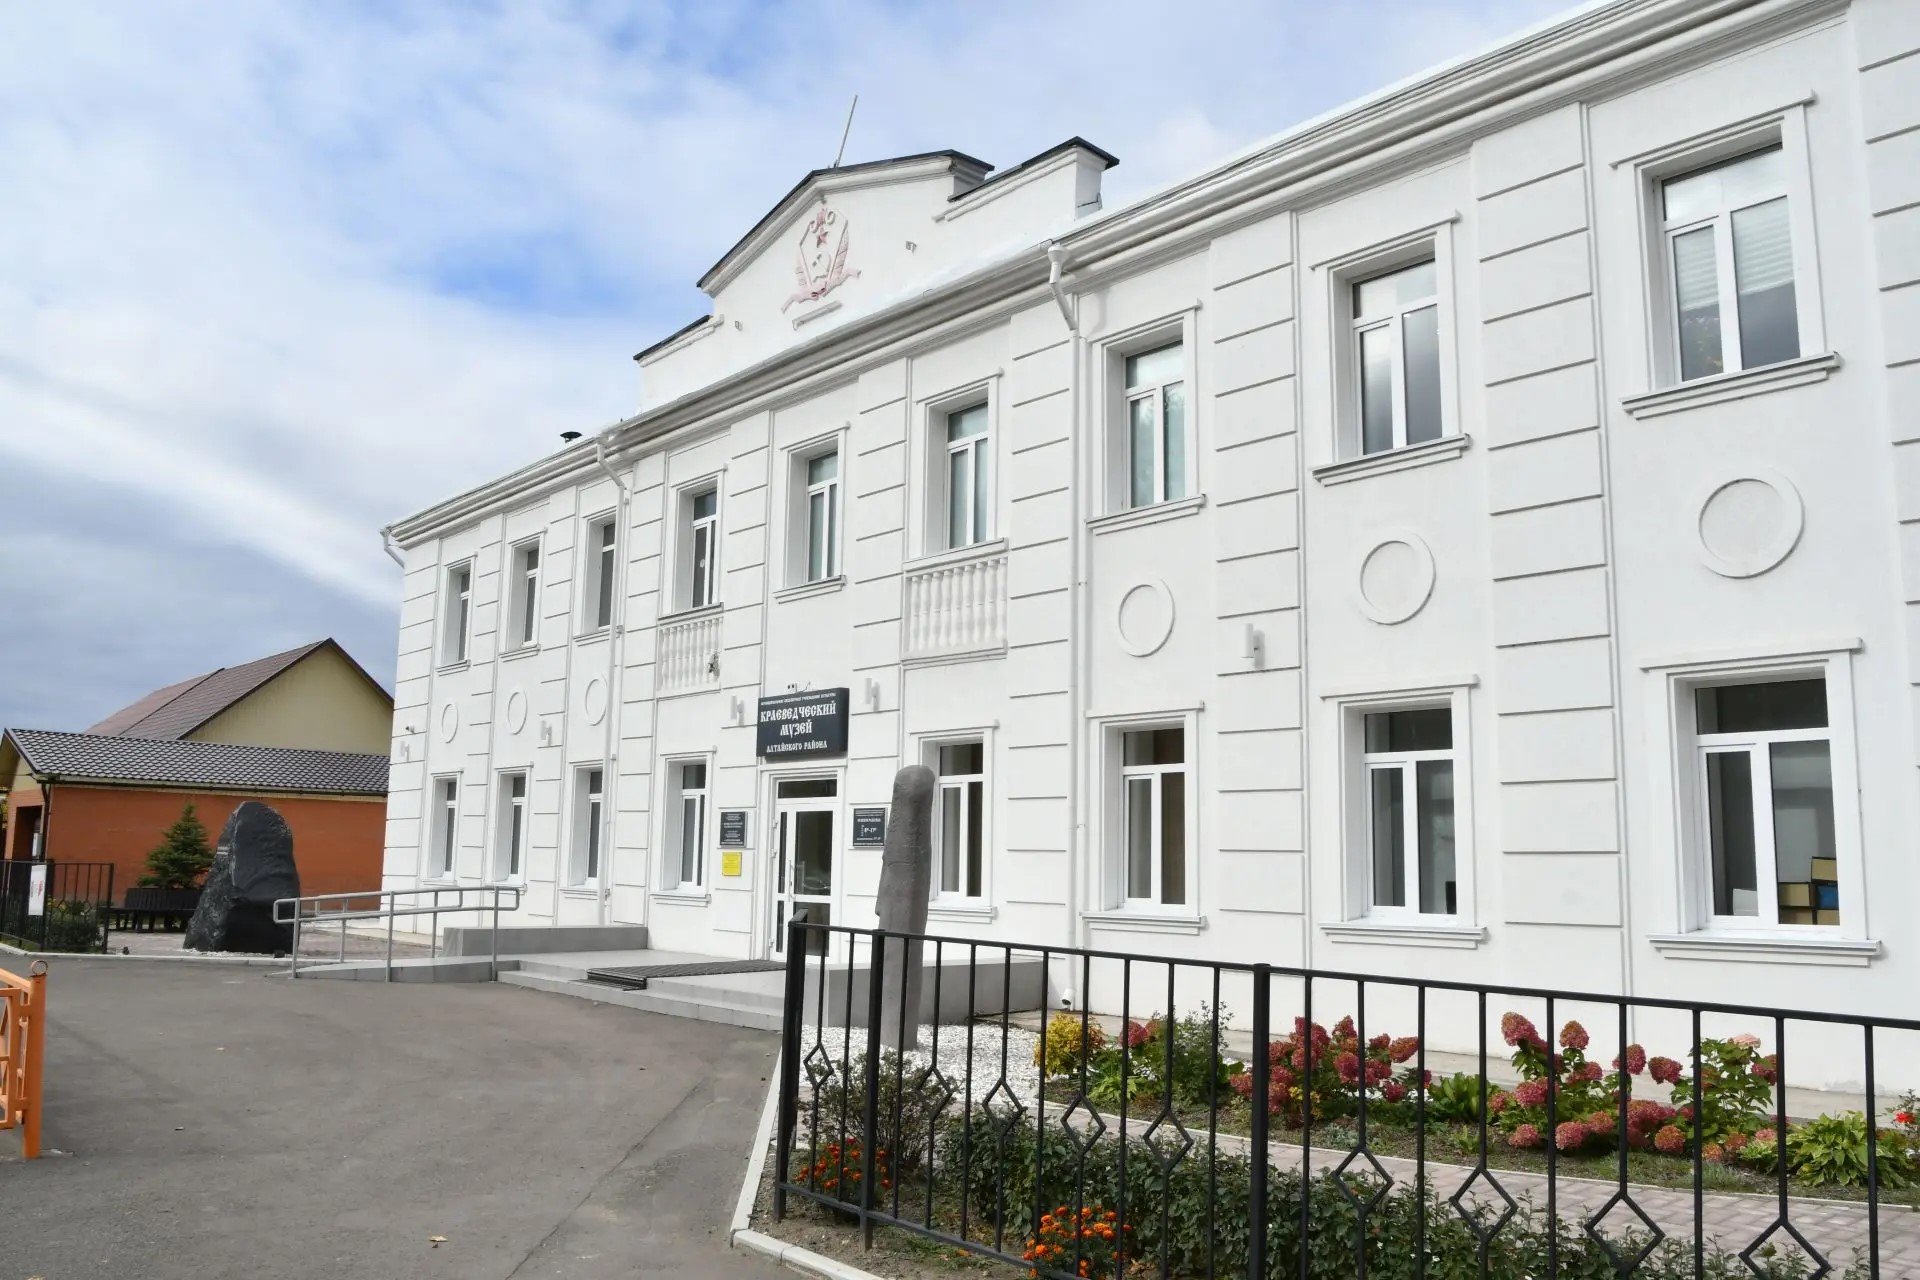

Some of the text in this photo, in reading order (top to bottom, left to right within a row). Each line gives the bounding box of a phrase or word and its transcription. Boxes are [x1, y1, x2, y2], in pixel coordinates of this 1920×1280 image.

[760, 701, 836, 722] КРАЕВЕДЧЕСКИЙ
[780, 719, 813, 738] МУЗЕЙ
[766, 740, 828, 753] АЛТАЙСКОГО РАЙОНА
